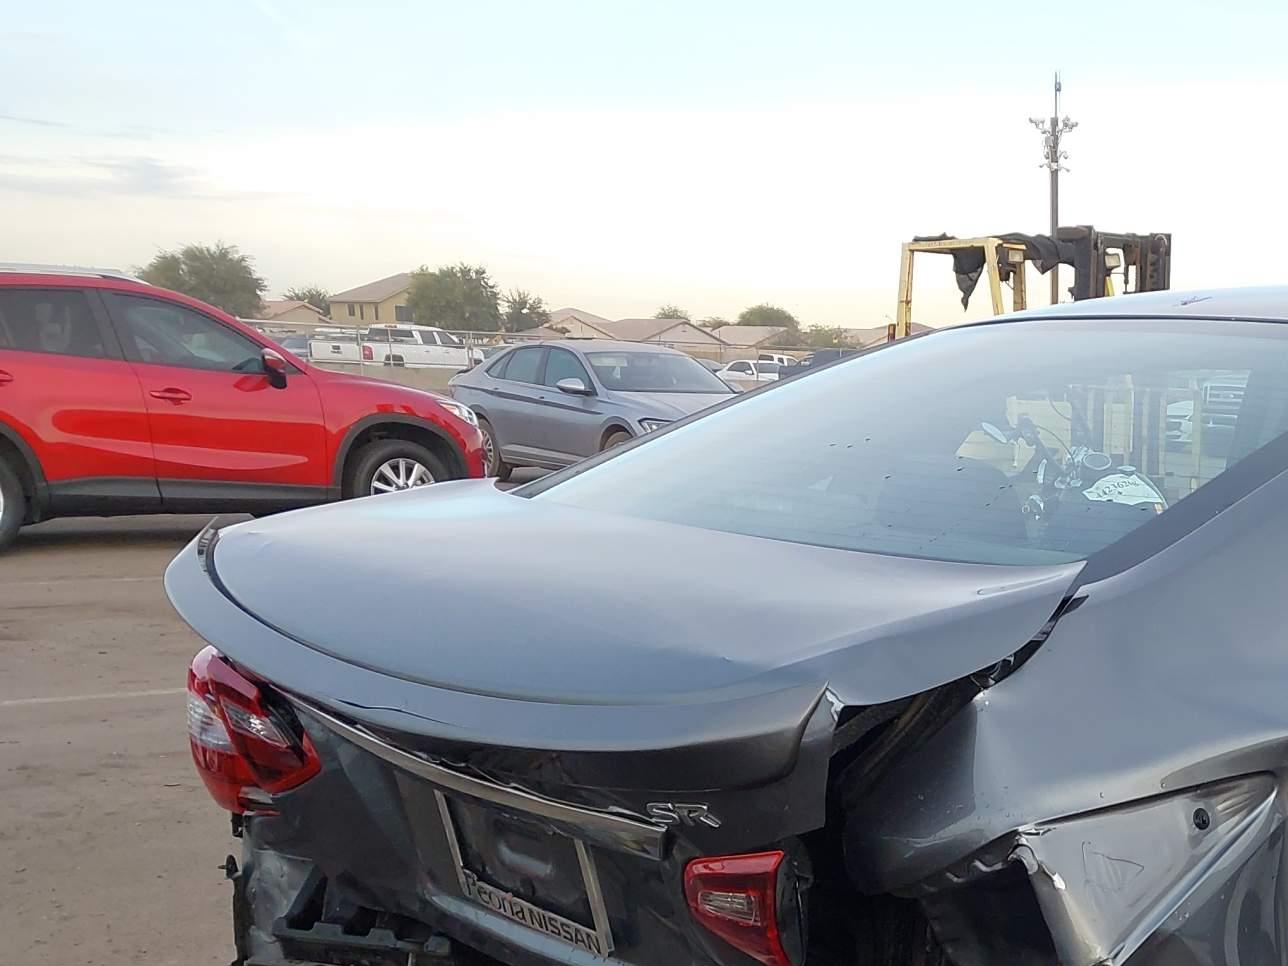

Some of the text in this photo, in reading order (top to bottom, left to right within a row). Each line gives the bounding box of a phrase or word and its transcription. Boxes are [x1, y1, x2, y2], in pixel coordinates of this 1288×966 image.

[646, 802, 722, 829] SR
[465, 872, 601, 954] Peoria NISSAN
